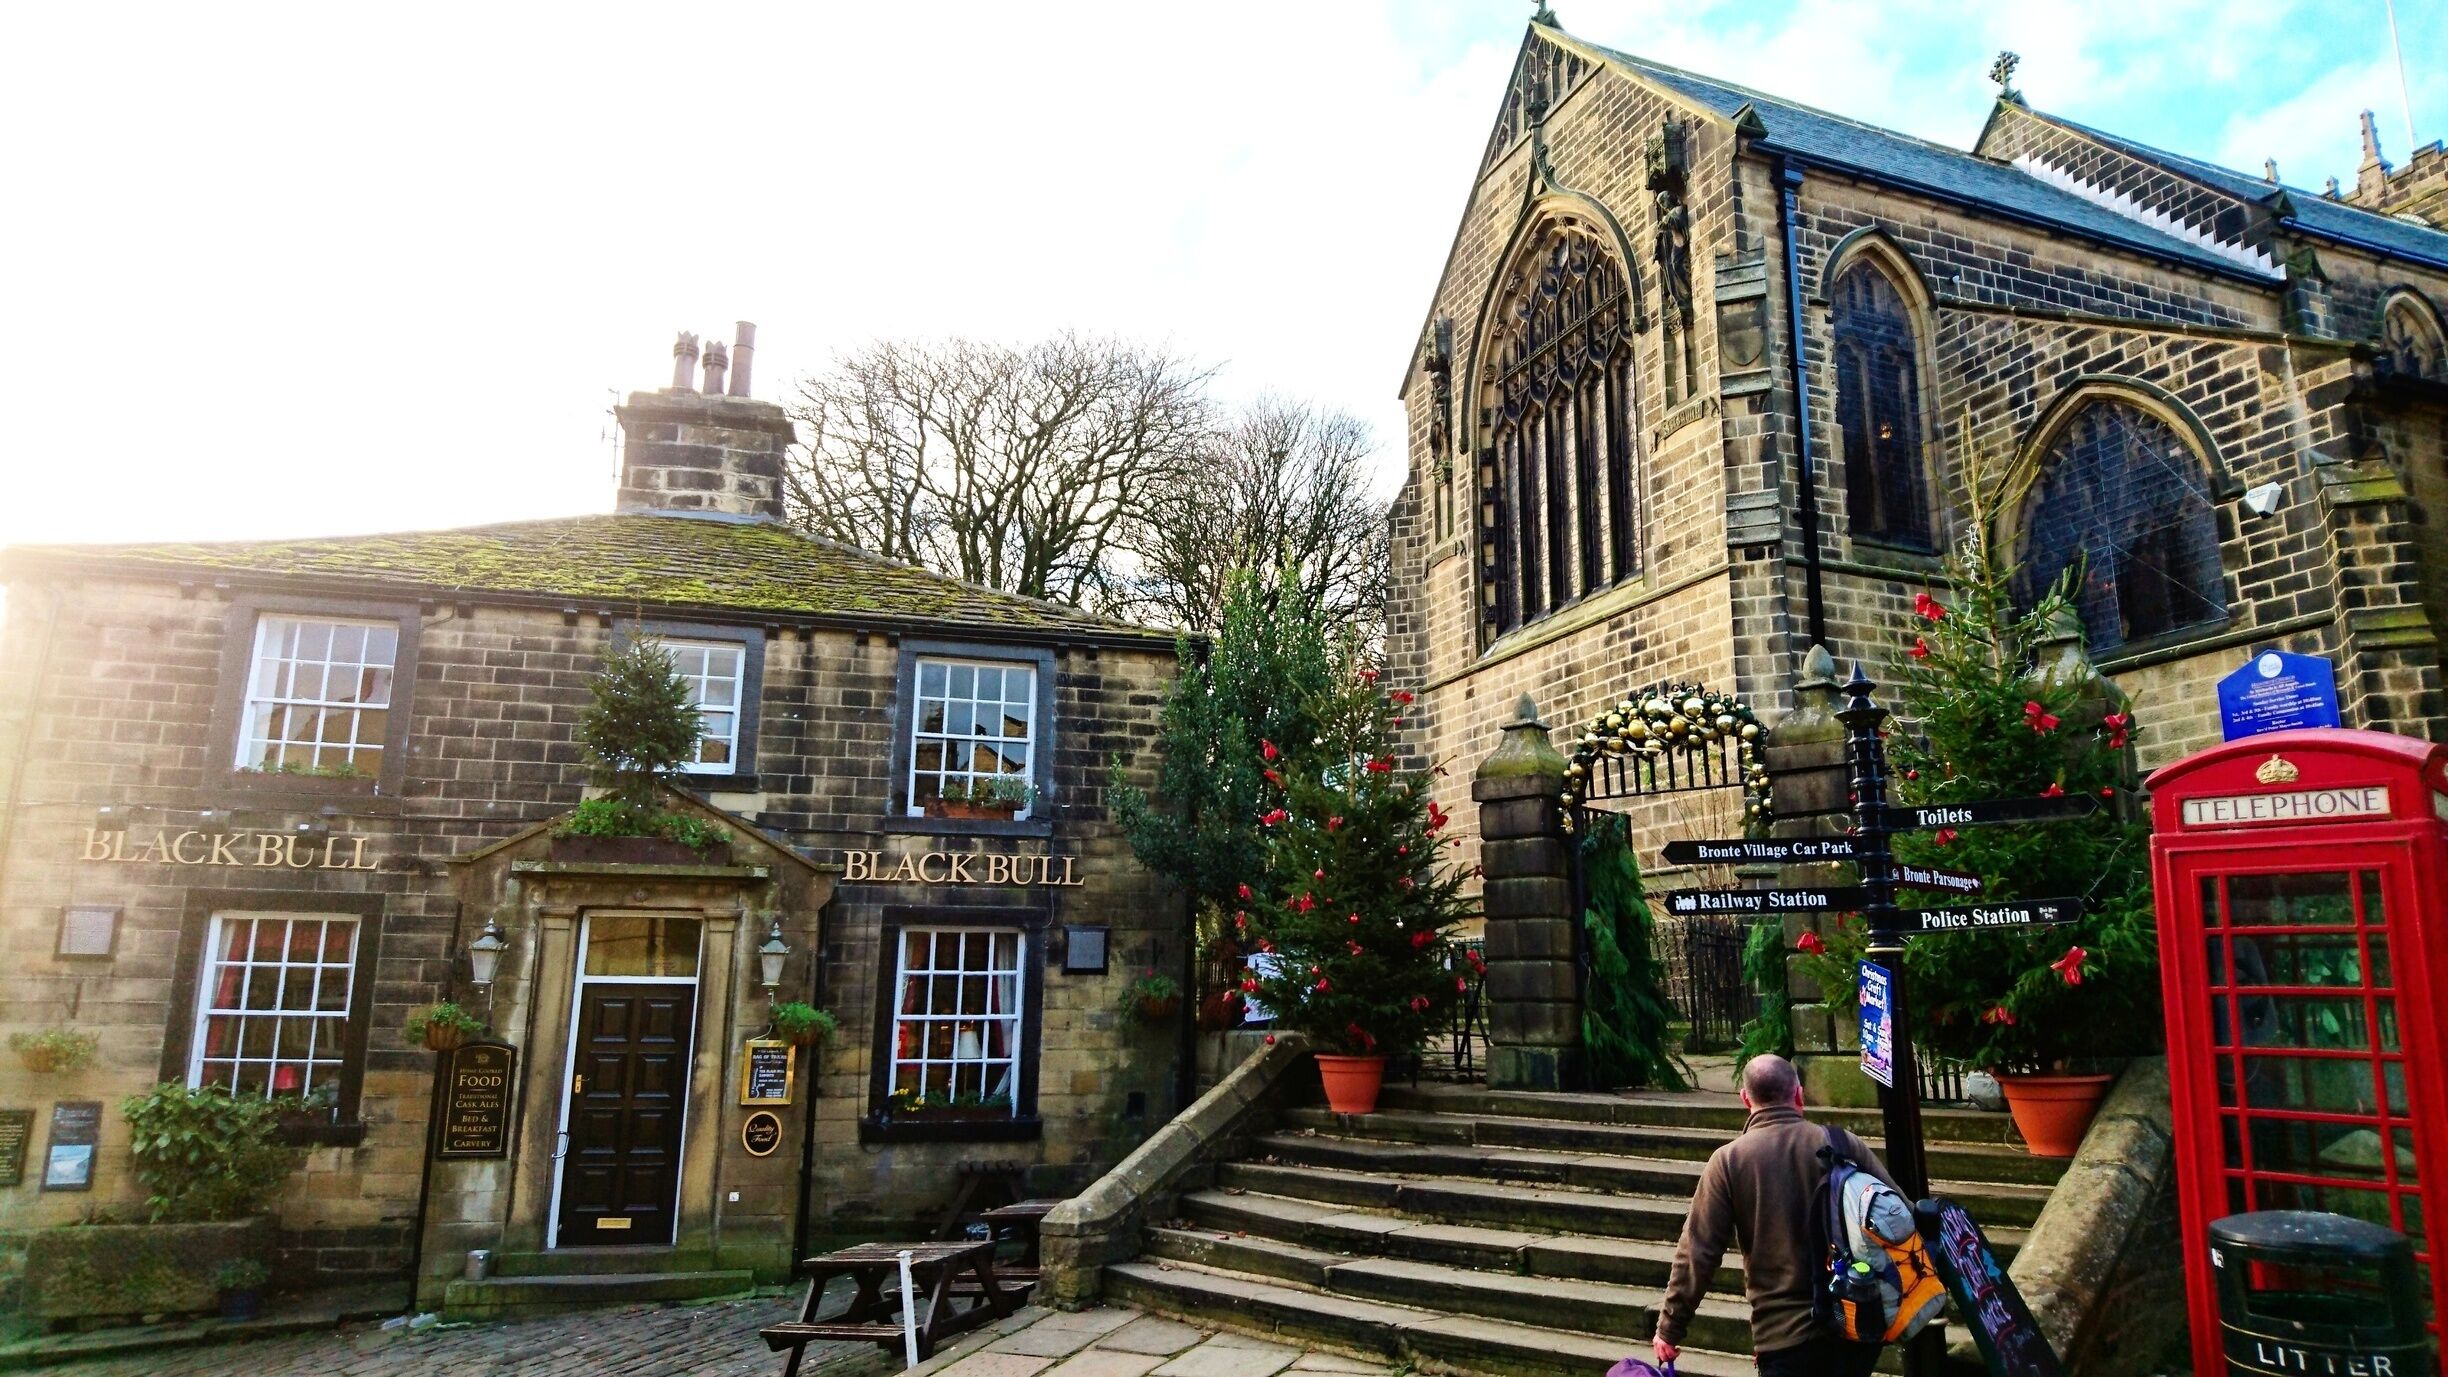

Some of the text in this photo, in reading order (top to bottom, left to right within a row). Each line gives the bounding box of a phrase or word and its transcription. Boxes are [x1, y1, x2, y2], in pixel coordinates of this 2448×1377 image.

[2190, 787, 2381, 822] TELEPHONE
[1917, 807, 1973, 826] Toilets
[79, 827, 379, 870] BLACK BULL
[1698, 841, 1853, 859] Bronte Village Car Park
[841, 850, 1085, 886] BLACK BULL
[1903, 866, 1974, 892] Bronte Parsonage
[1700, 891, 1828, 911] Railway Station
[1921, 910, 1968, 929] Police
[1972, 907, 2031, 926] Station
[1862, 965, 1887, 986] Christmas
[1866, 990, 1886, 1010] Market
[458, 1074, 502, 1087] FOOD
[452, 1125, 498, 1133] BREAKFAST
[462, 1115, 489, 1123] BED &
[748, 1123, 775, 1134] Quality
[453, 1140, 492, 1148] CARVERY
[2256, 1342, 2394, 1377] LITTER
